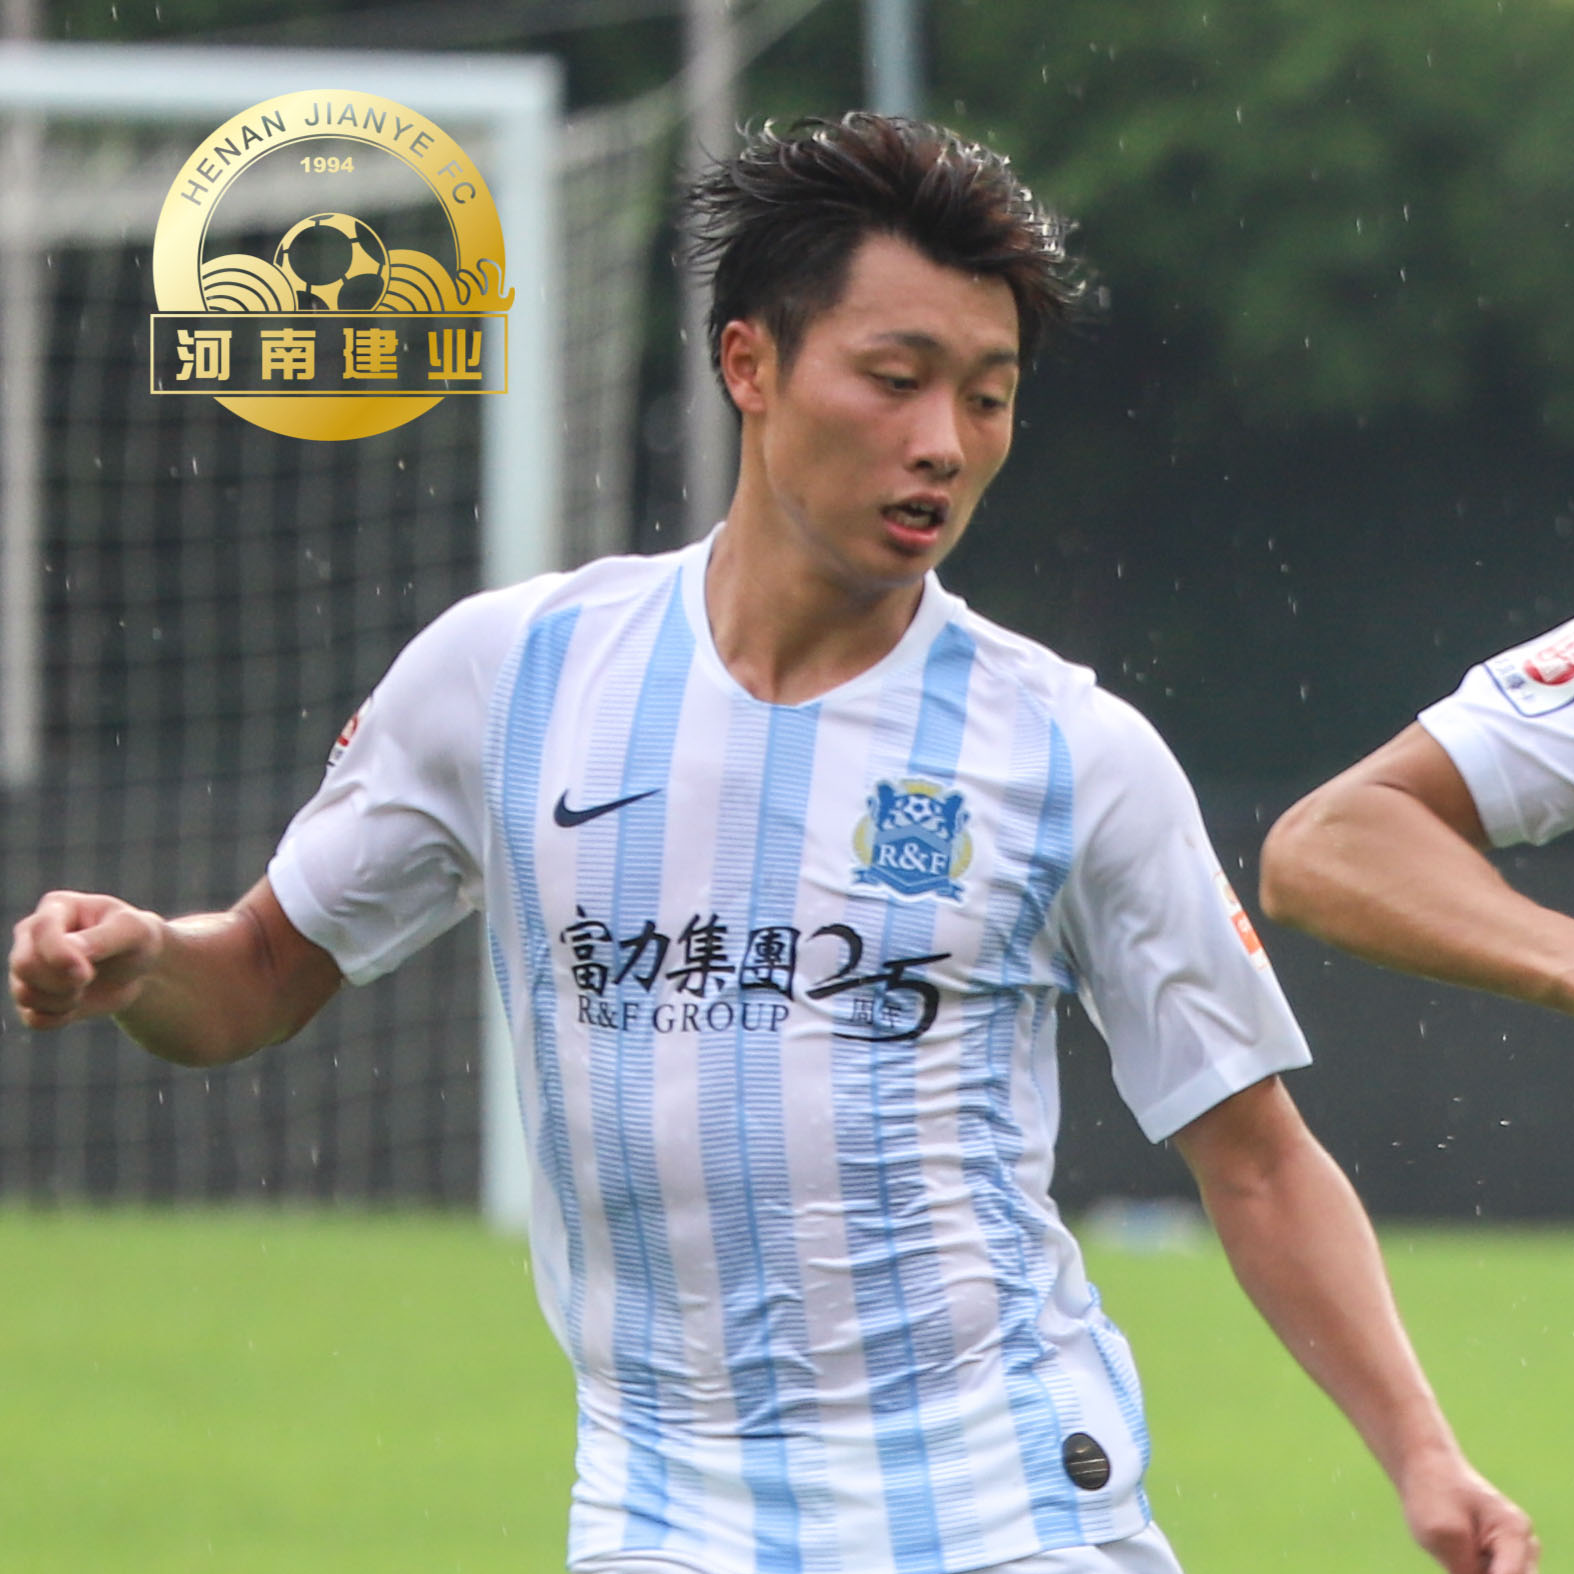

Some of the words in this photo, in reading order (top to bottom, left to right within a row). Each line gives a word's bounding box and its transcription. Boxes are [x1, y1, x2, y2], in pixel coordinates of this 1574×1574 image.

[878, 842, 948, 875] R&F
[560, 904, 801, 1002] 富力集團
[577, 994, 640, 1032] R&F
[651, 1001, 790, 1034] GROUP
